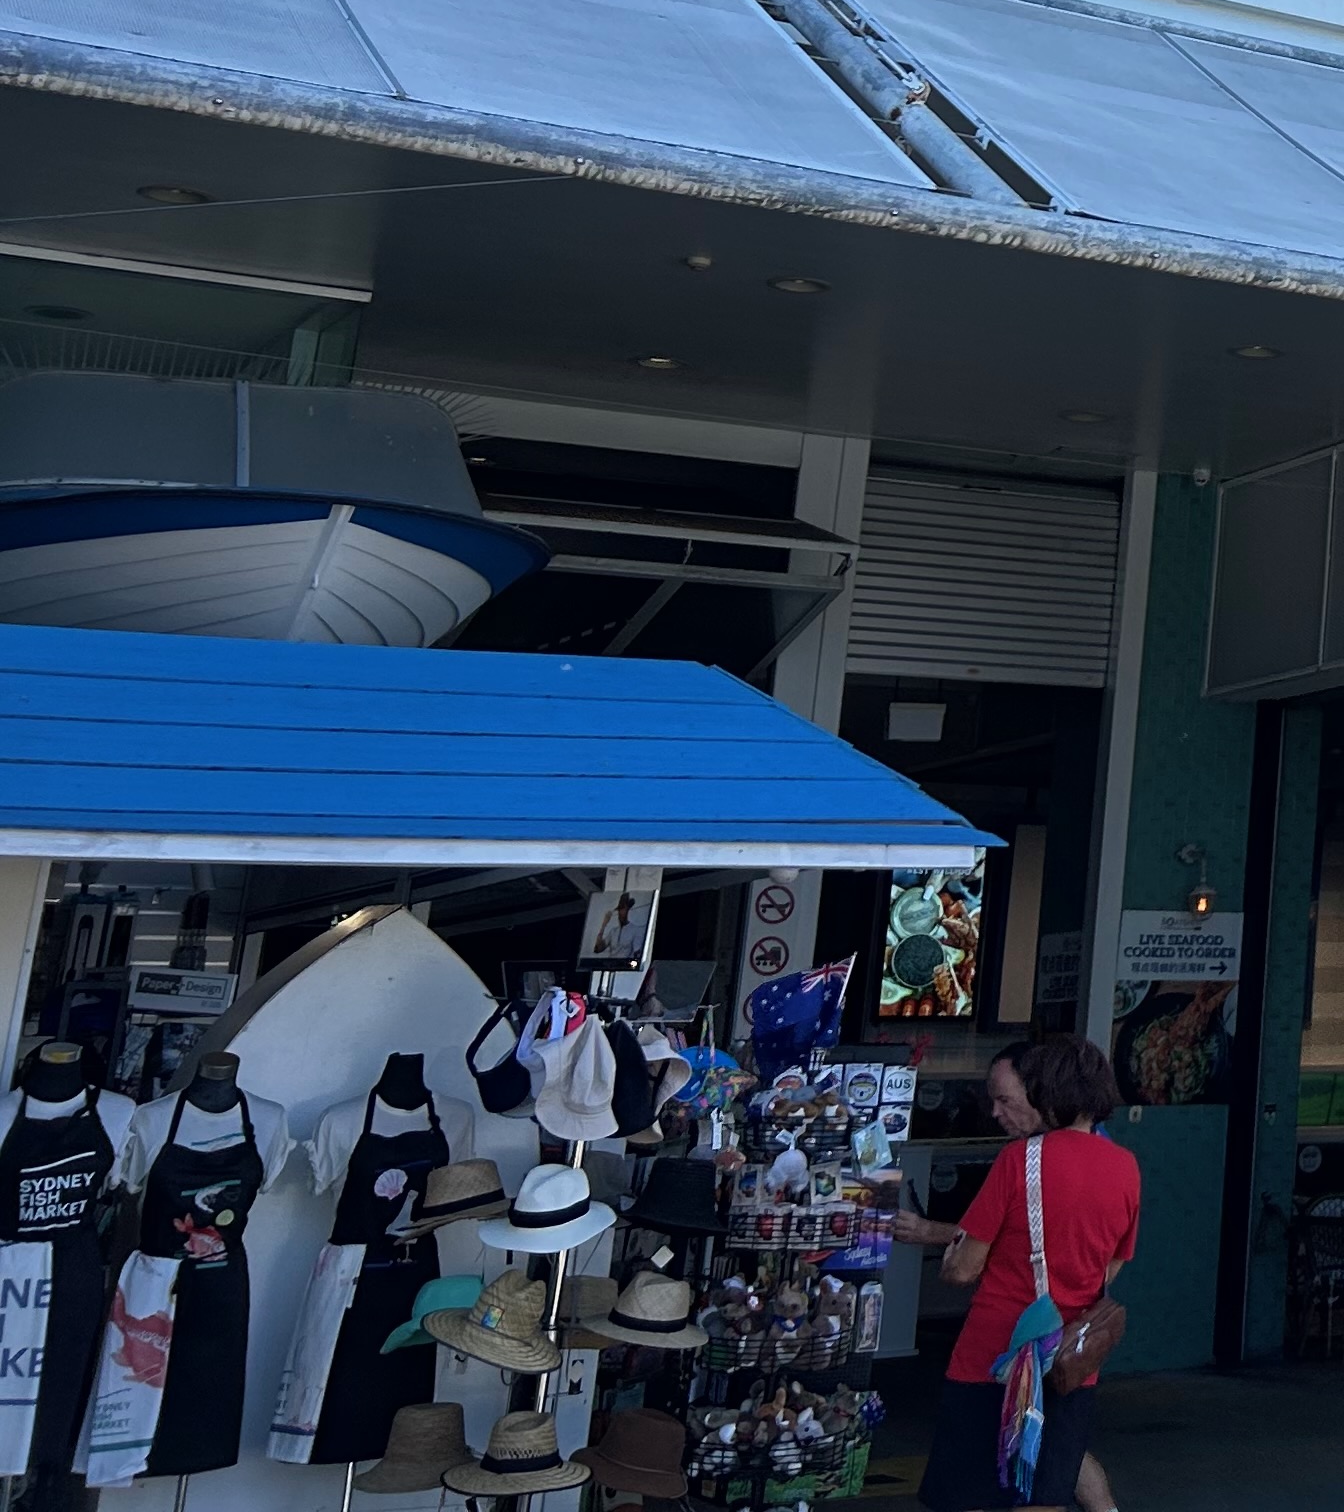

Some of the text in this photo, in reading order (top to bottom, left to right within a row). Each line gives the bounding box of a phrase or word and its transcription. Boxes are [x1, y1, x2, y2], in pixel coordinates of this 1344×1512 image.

[1138, 934, 1166, 945] LIVE
[1123, 946, 1176, 958] COOKED
[1177, 947, 1194, 958] TO
[886, 1077, 911, 1089] AUS
[19, 1171, 96, 1194] SYDNEY
[19, 1191, 61, 1207] FISH
[18, 1199, 89, 1222] MARKET
